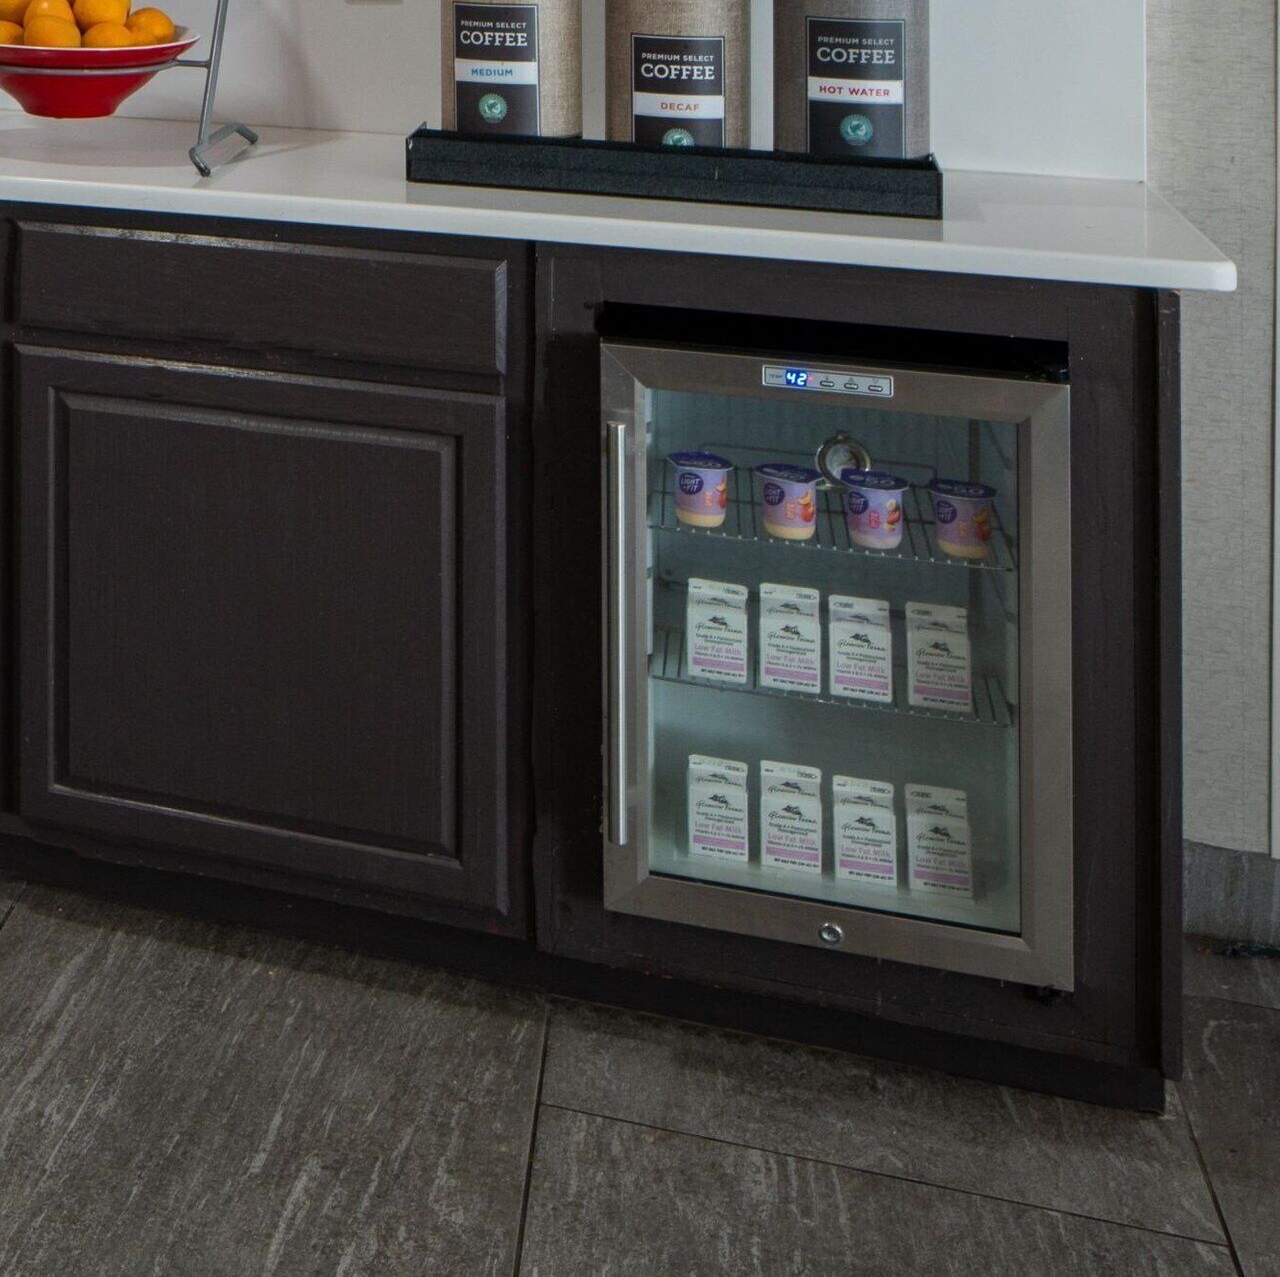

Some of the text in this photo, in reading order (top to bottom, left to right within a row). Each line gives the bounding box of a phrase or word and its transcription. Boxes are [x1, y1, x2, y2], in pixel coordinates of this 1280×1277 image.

[461, 20, 493, 28] PREMIUM
[460, 30, 529, 46] COFFEE
[818, 36, 895, 46] PREMIUM SELECT
[642, 53, 680, 61] PREMIUM
[817, 47, 895, 64] COFFEE
[471, 68, 513, 76] MEDIUM
[641, 63, 715, 80] COFFEE
[819, 85, 890, 97] HOT WATER
[661, 102, 700, 111] DECAF
[786, 372, 808, 385] 42
